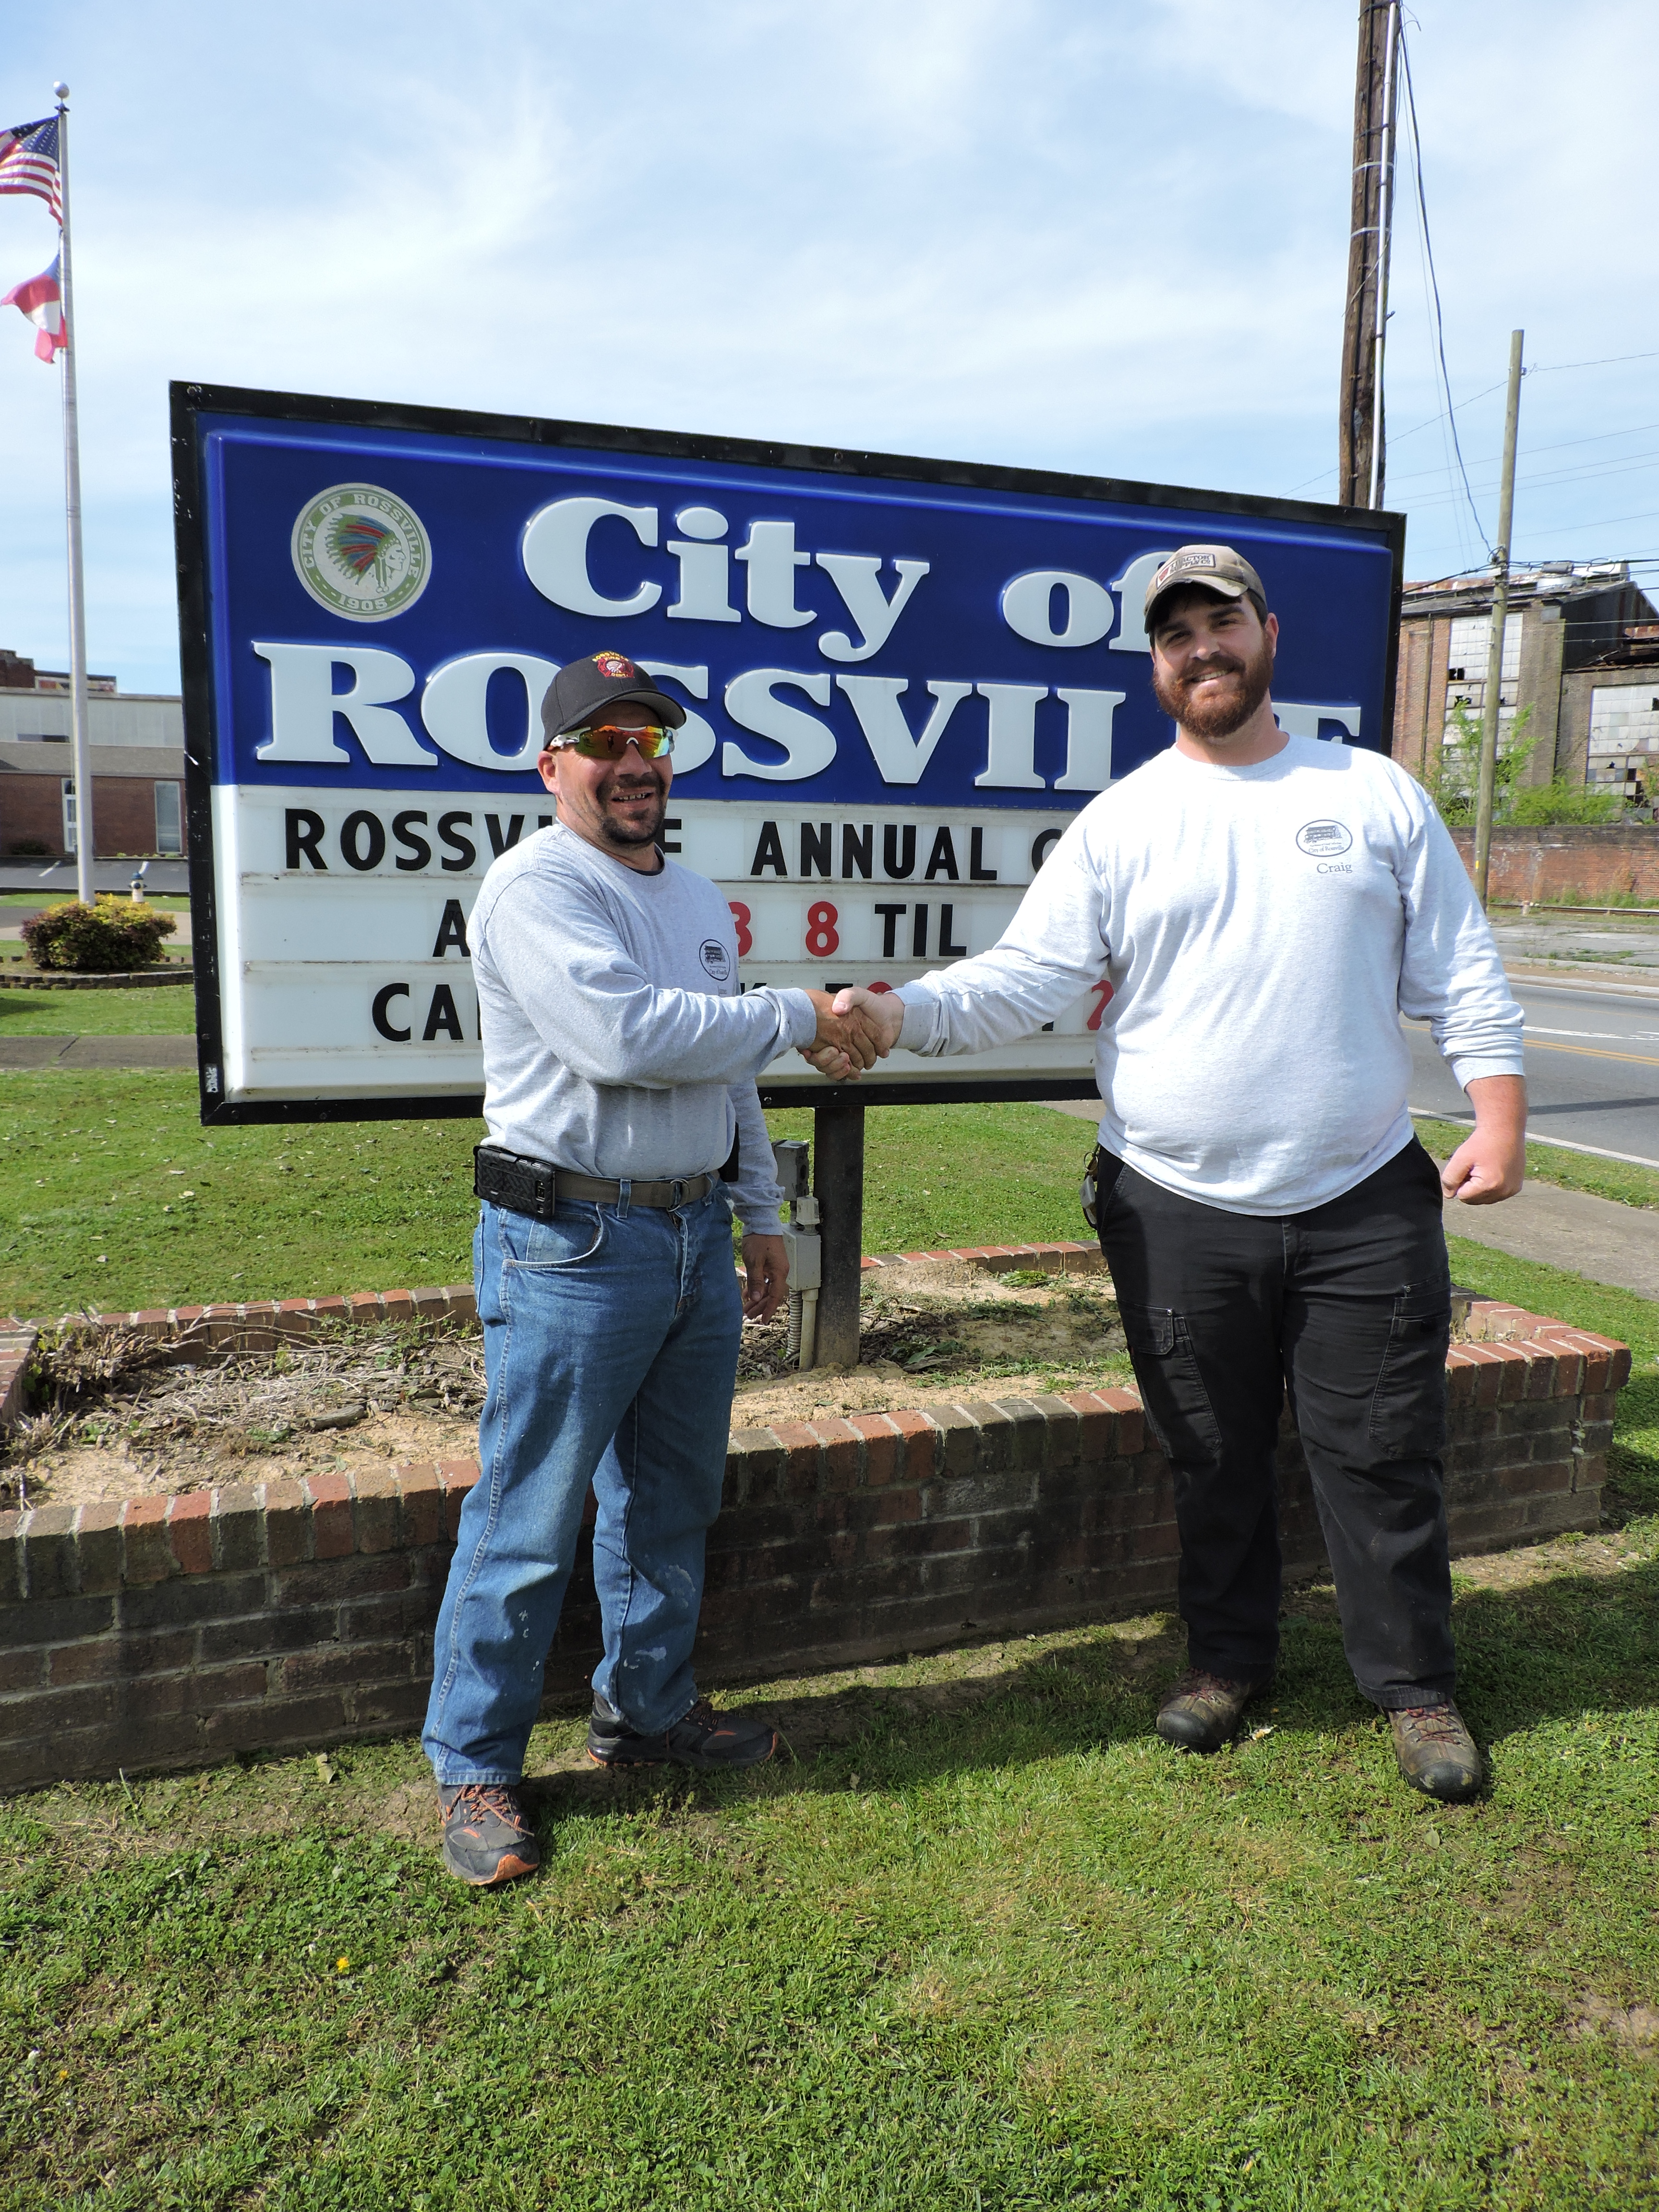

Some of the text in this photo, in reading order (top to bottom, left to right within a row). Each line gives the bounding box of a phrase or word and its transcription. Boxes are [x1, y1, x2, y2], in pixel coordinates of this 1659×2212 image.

[301, 493, 422, 578] CITY OF ROSSVILLE
[338, 594, 388, 611] 1905
[523, 496, 929, 662] City
[252, 640, 1361, 791] ROSVIL
[750, 821, 998, 881] ANNUAL
[1317, 862, 1353, 874] Craig
[805, 901, 839, 957] 8
[874, 903, 967, 957] TIL
